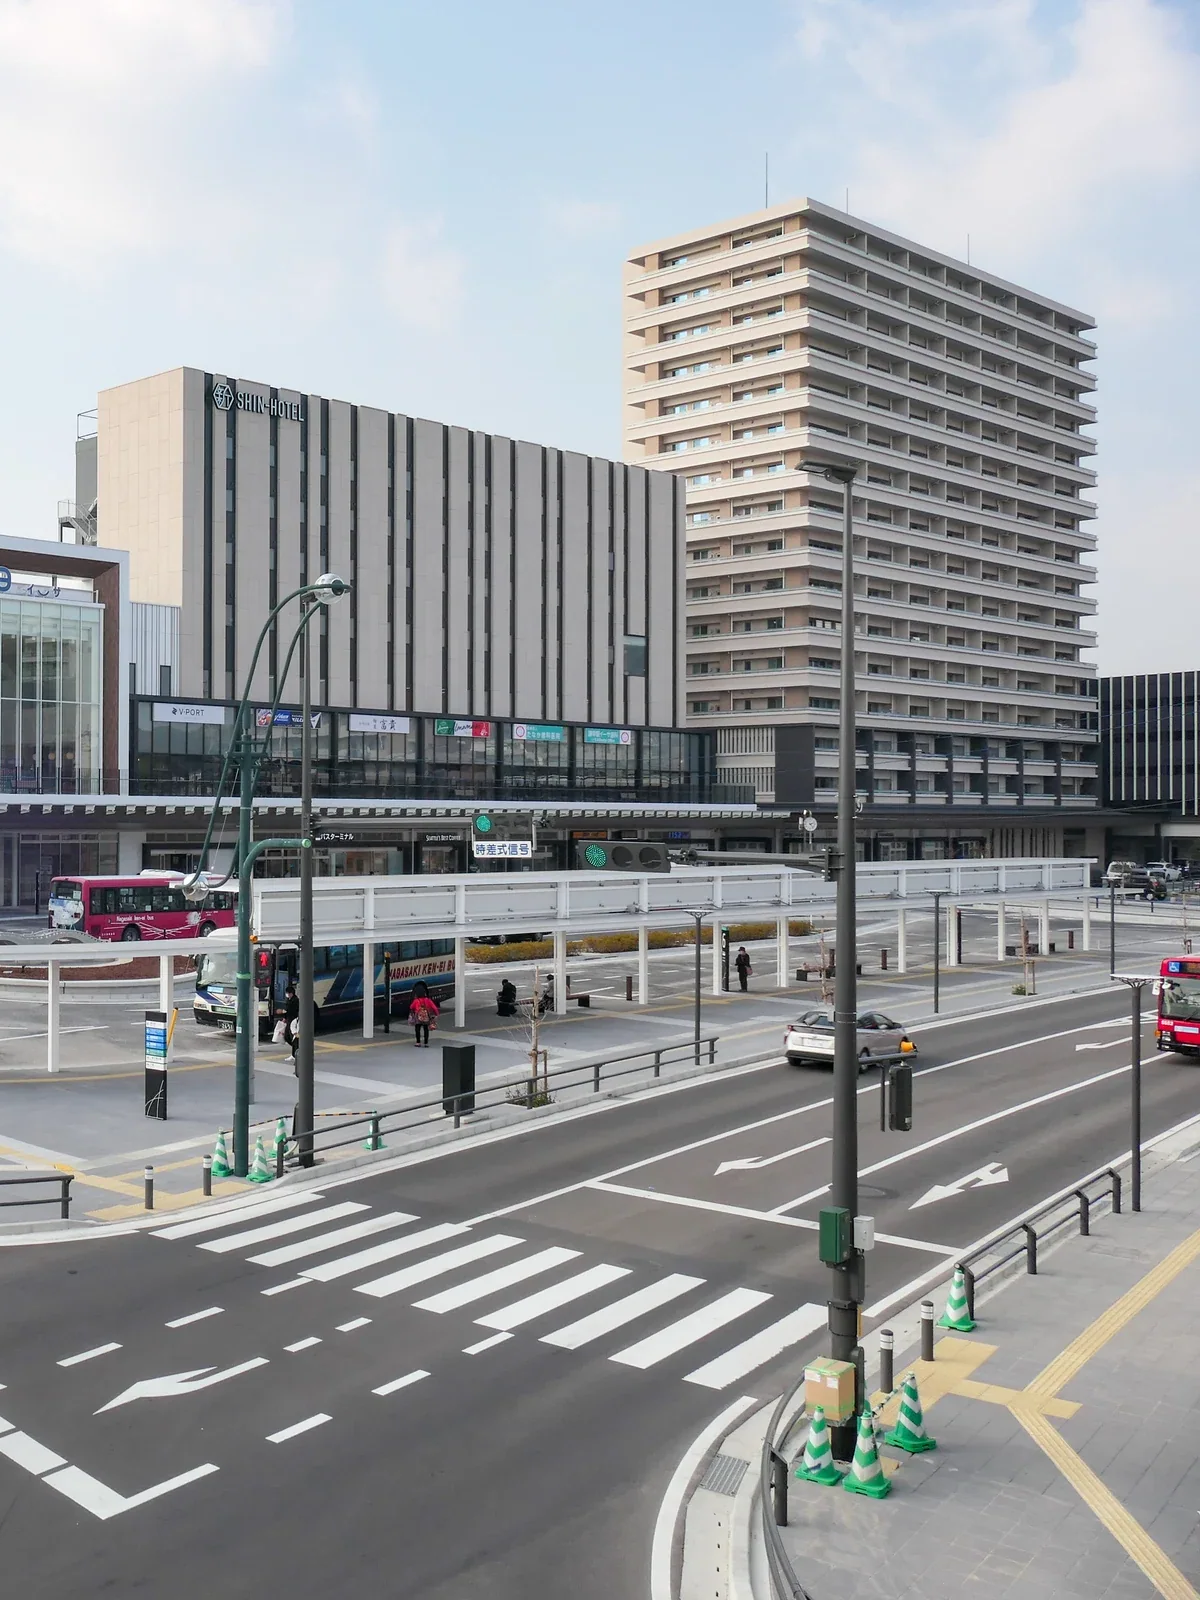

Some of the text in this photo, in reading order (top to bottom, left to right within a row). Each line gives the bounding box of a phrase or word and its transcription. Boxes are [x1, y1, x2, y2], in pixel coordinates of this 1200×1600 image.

[237, 392, 304, 421] SHIN-HOTEL
[475, 843, 529, 856] 時差式信号
